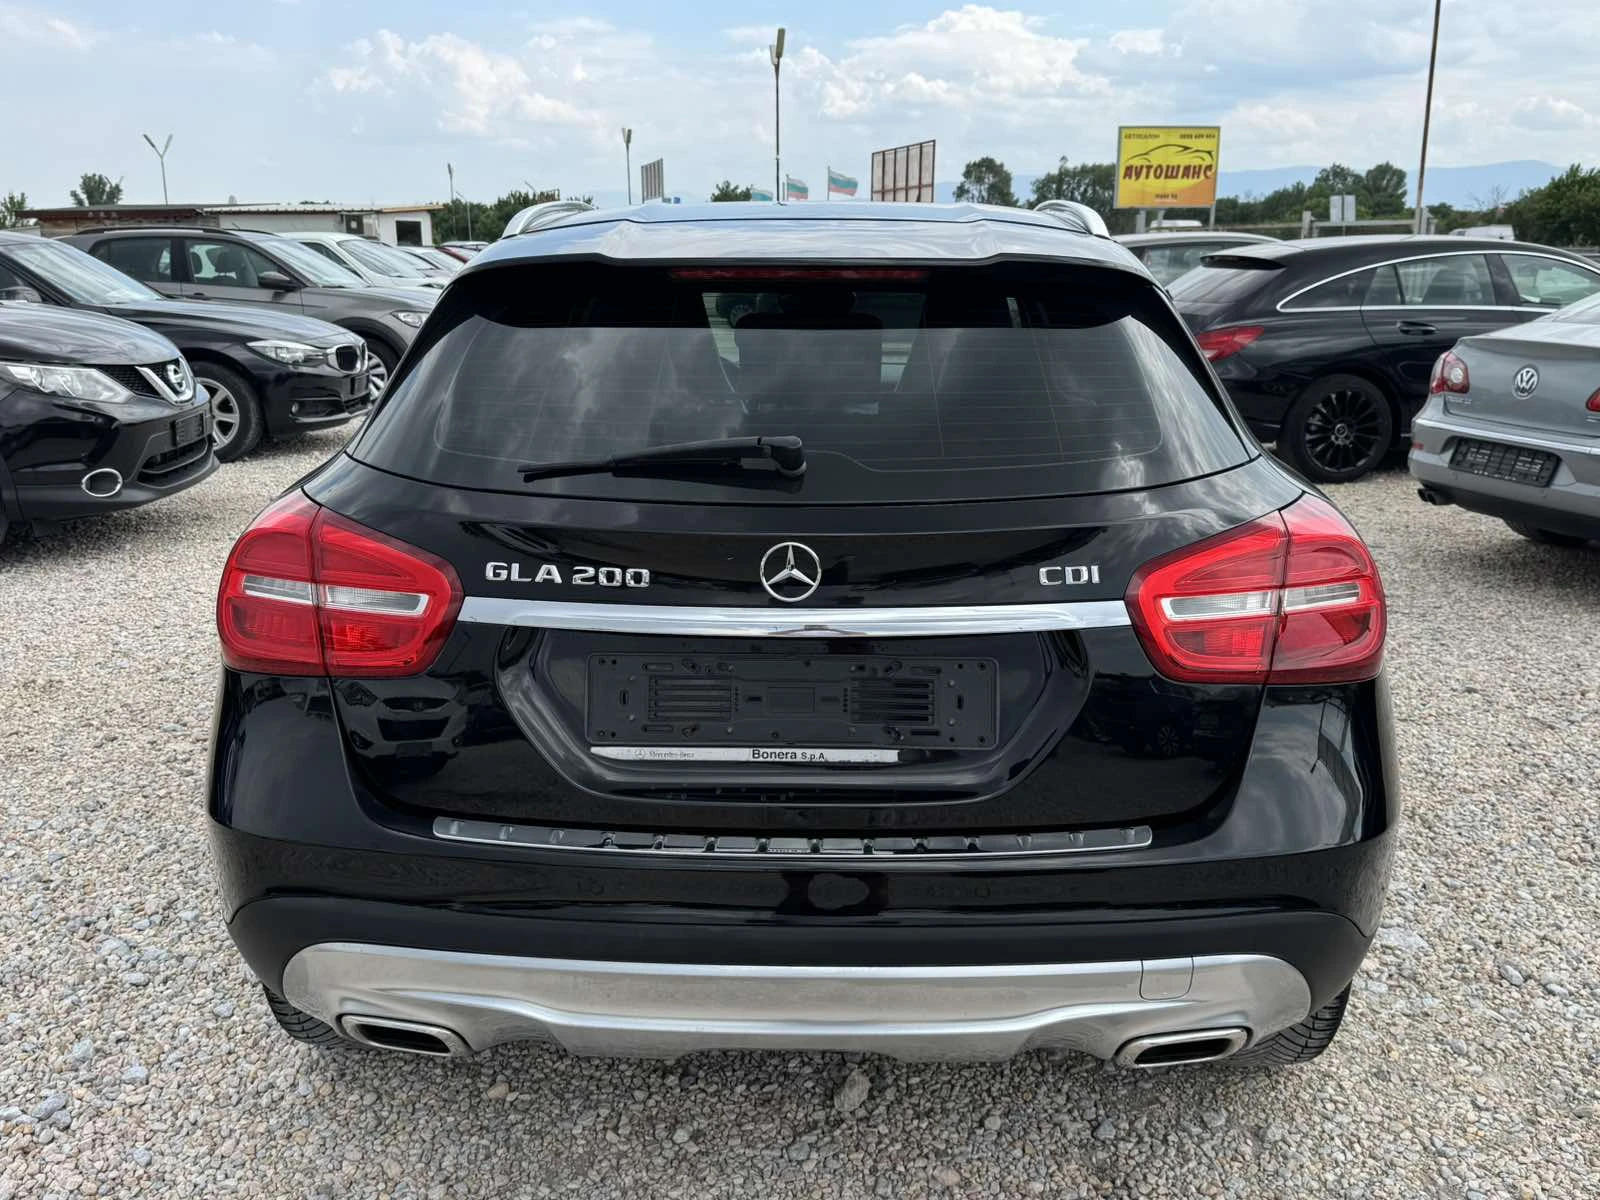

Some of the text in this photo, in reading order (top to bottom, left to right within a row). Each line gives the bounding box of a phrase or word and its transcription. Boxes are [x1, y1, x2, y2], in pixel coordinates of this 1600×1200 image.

[1123, 164, 1213, 181] АУТОШАНС
[485, 561, 650, 588] GLA 200
[1039, 565, 1100, 585] CDI
[752, 749, 797, 760] Bonera
